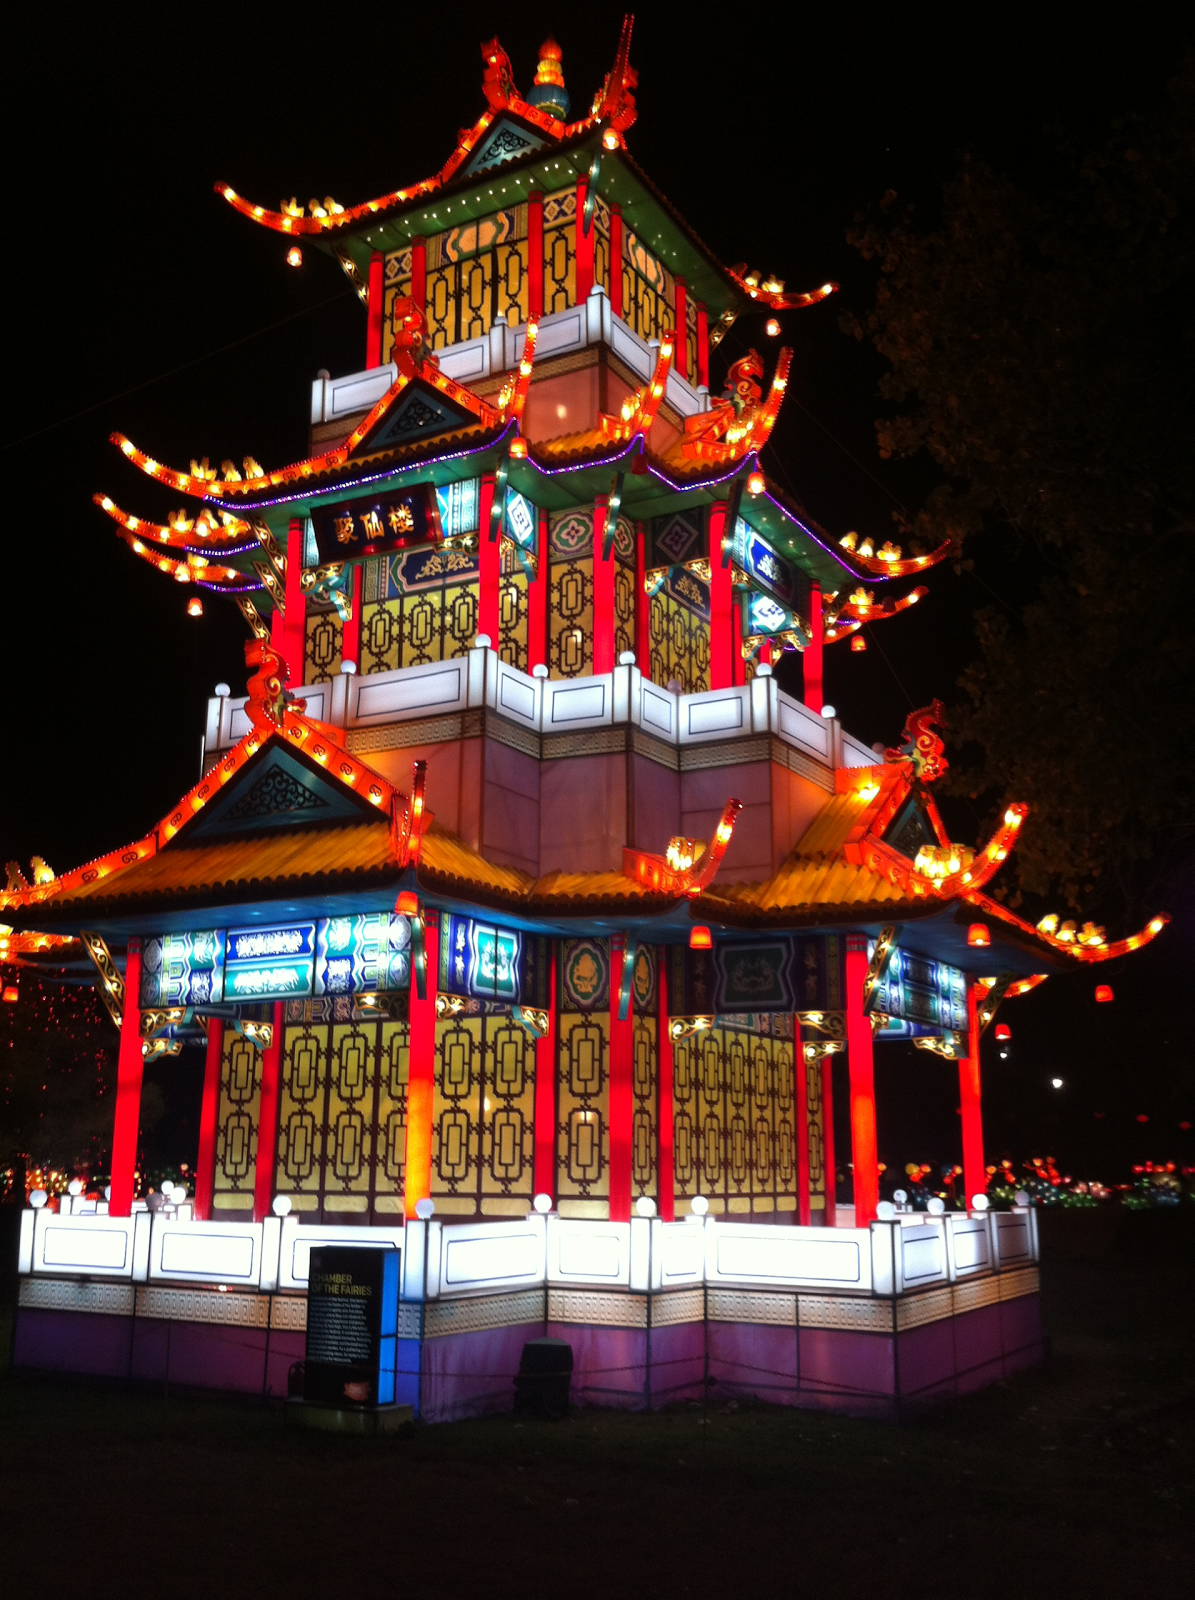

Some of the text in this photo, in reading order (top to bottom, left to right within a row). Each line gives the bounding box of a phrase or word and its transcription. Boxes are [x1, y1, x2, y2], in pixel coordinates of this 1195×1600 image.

[312, 1273, 352, 1284] CHAMBER
[312, 1284, 372, 1296] OF THE FAIRIES
